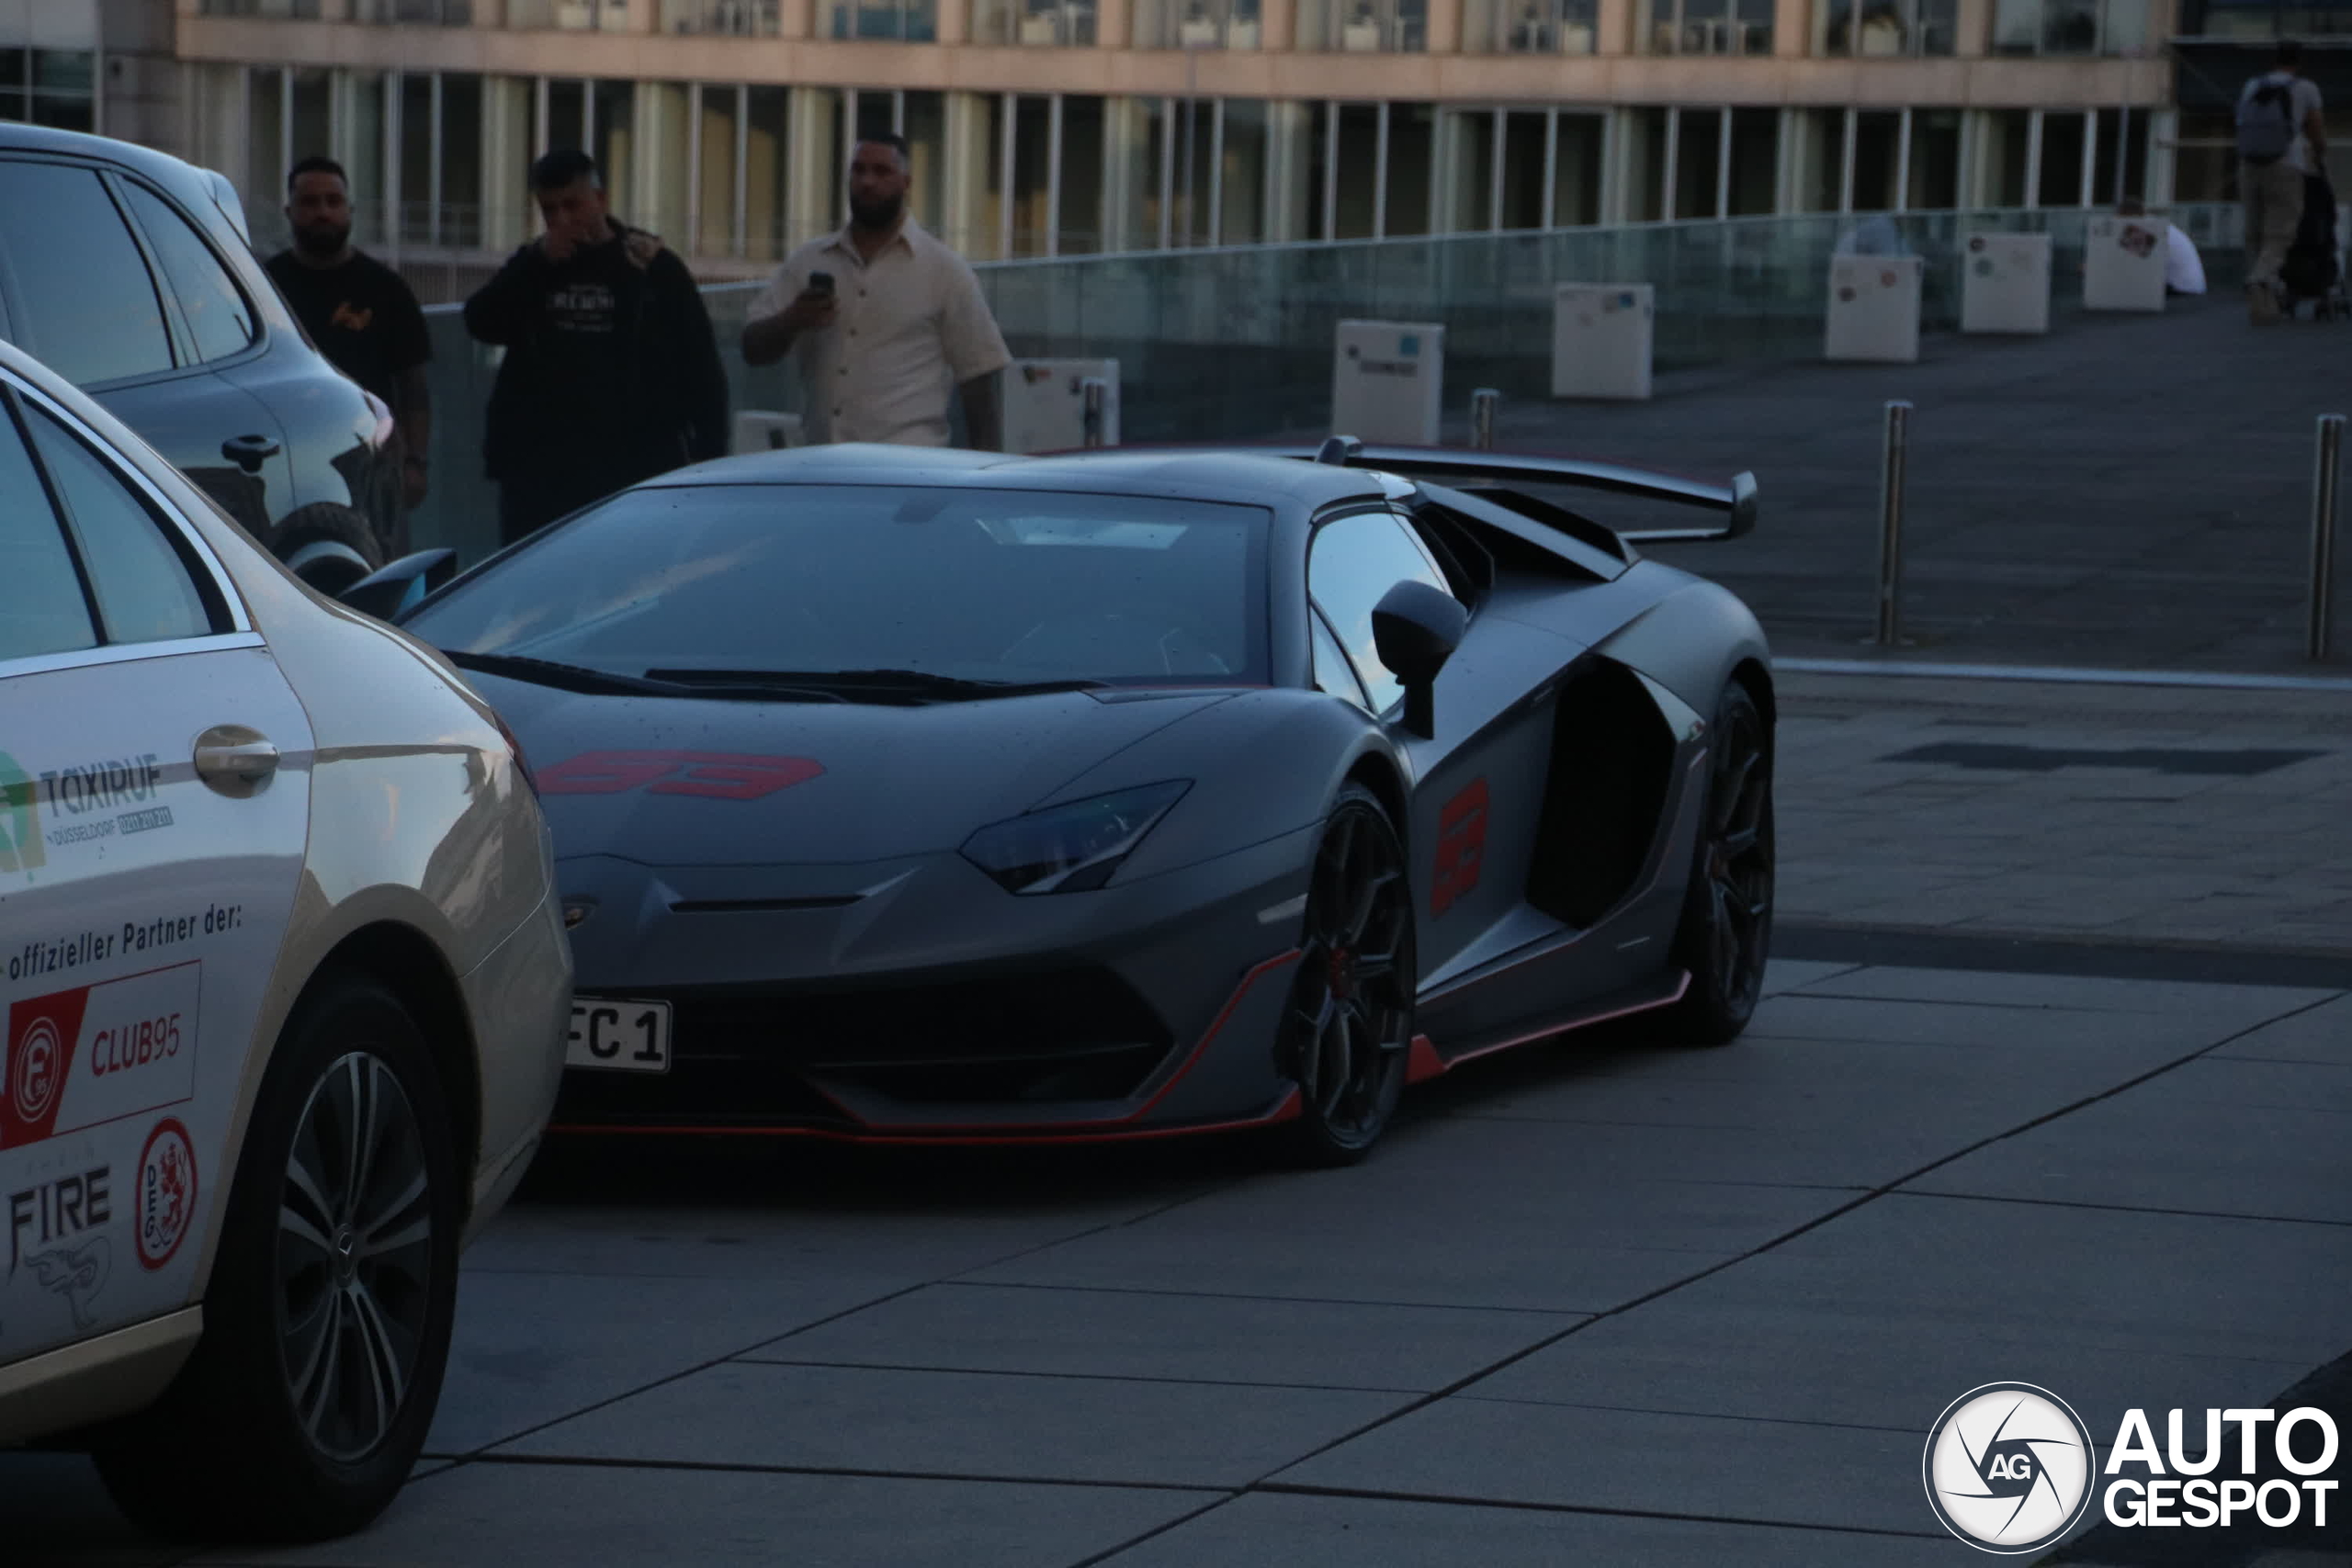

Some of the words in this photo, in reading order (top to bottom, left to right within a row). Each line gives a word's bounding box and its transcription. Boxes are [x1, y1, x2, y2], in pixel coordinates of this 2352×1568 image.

[9, 932, 116, 980] offizieller
[122, 915, 198, 953] Partner
[204, 903, 243, 935] der:
[92, 1012, 182, 1077] CLUB95
[633, 1010, 664, 1063] 1
[8, 1165, 111, 1284] FIRE
